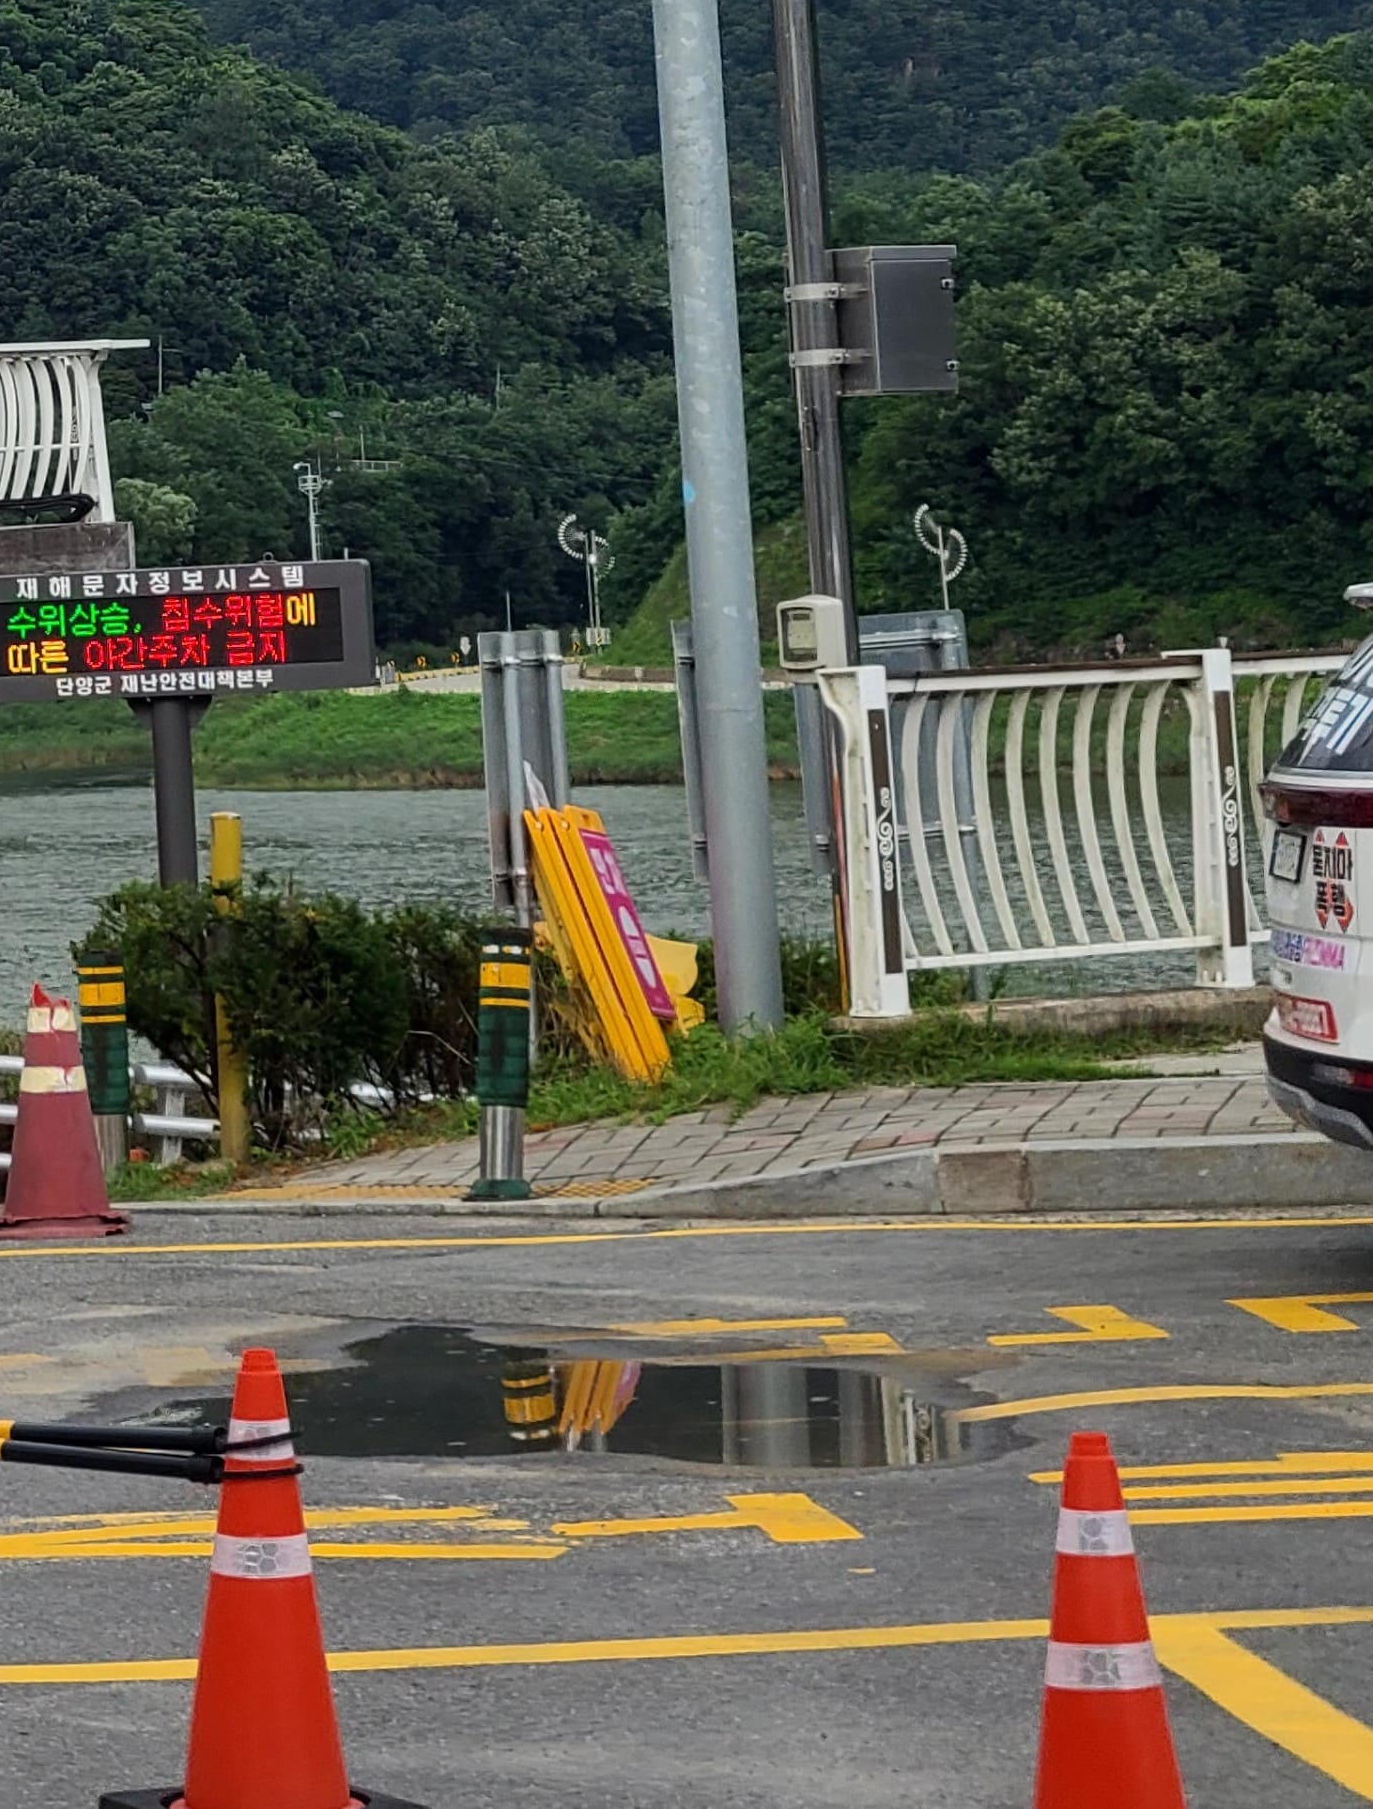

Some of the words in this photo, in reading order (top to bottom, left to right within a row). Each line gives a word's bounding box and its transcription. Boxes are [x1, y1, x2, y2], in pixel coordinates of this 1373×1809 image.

[17, 565, 304, 599] 재해문자정보시스템
[7, 603, 142, 638] 수위상승,
[161, 592, 316, 631] 침수위험에
[7, 640, 69, 675] 따른
[83, 633, 209, 670] 야간주차
[226, 630, 287, 666] 금지
[56, 676, 112, 697] 단양군
[121, 669, 274, 694] 재난안전대책본부
